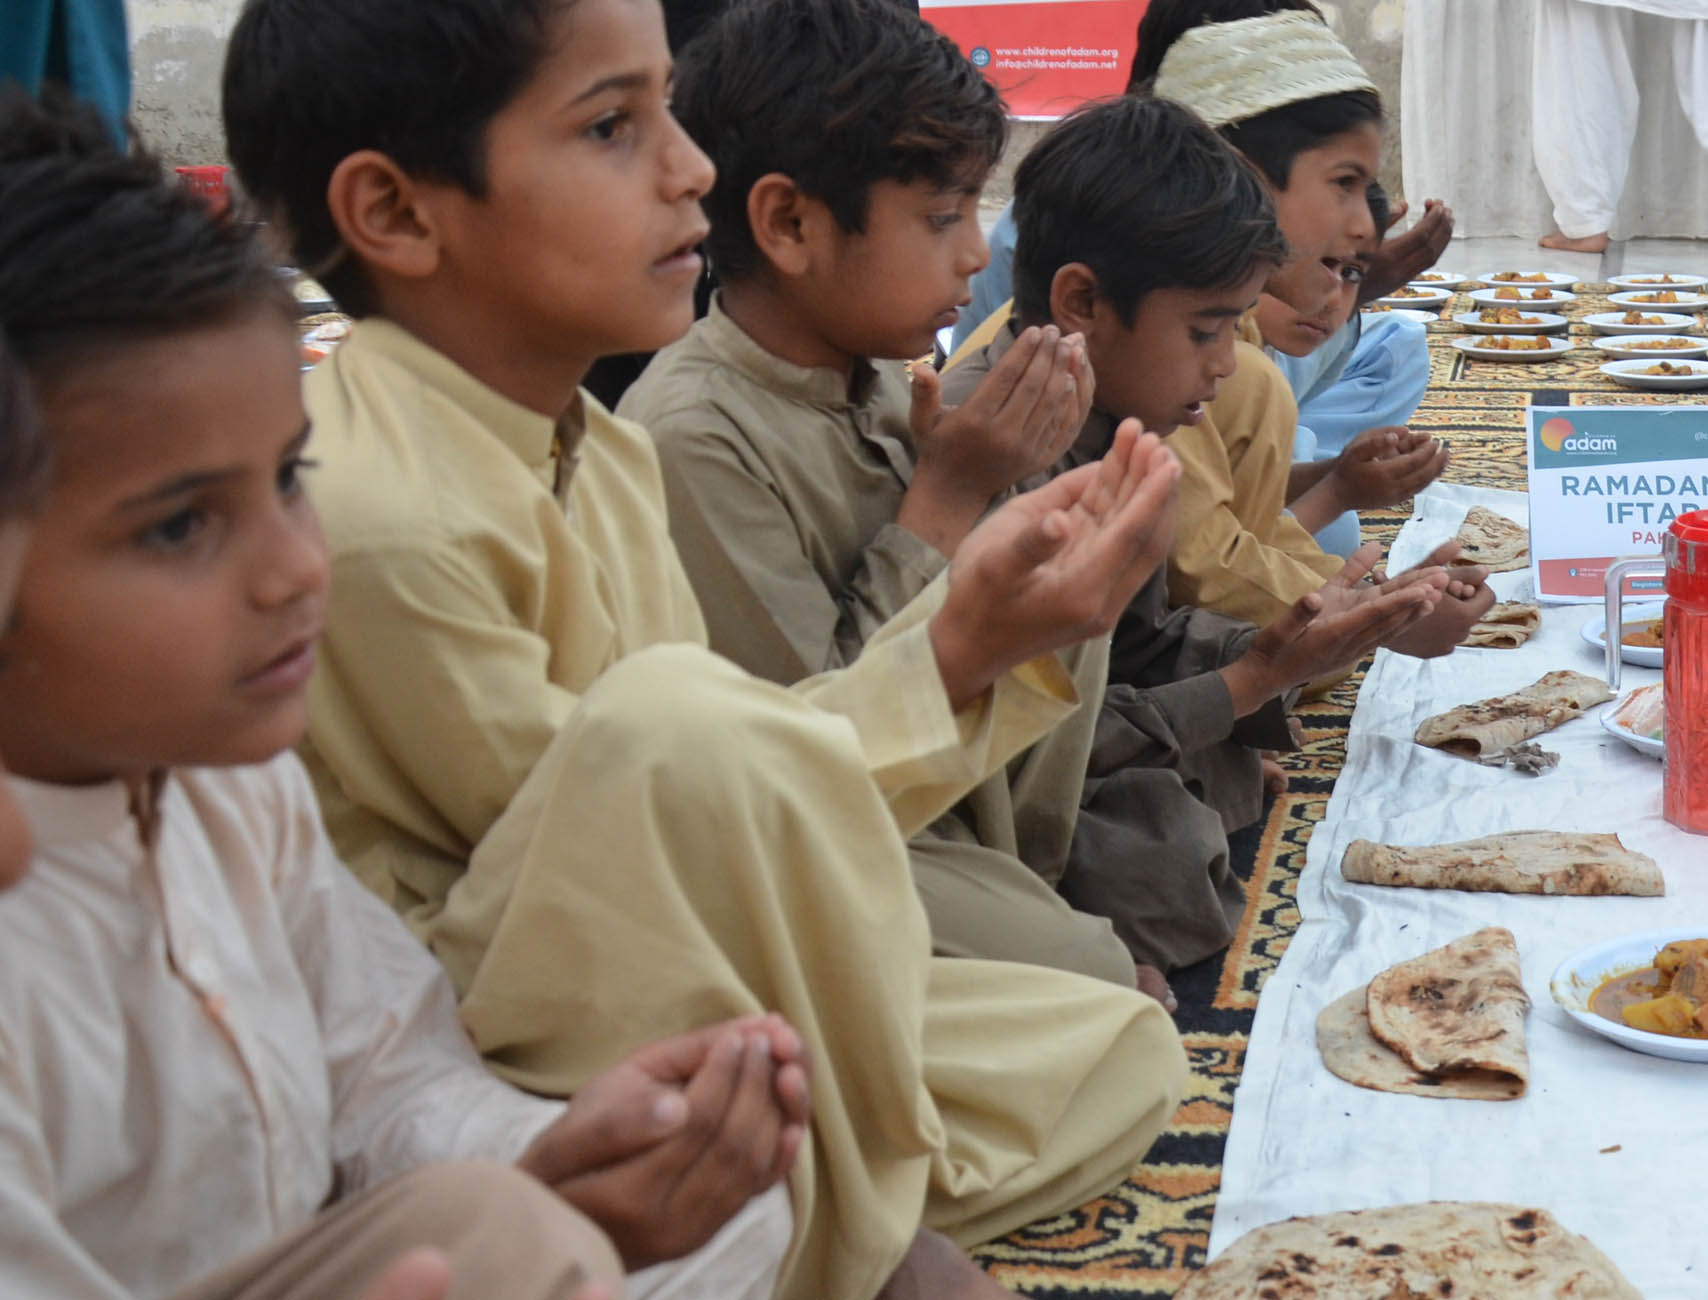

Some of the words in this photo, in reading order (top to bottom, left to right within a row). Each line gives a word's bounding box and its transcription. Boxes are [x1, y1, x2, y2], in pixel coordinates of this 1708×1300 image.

[996, 47, 1119, 58] www.childrenofadam.org
[996, 58, 1117, 69] info@childrenofadam.net
[1564, 432, 1617, 451] adam
